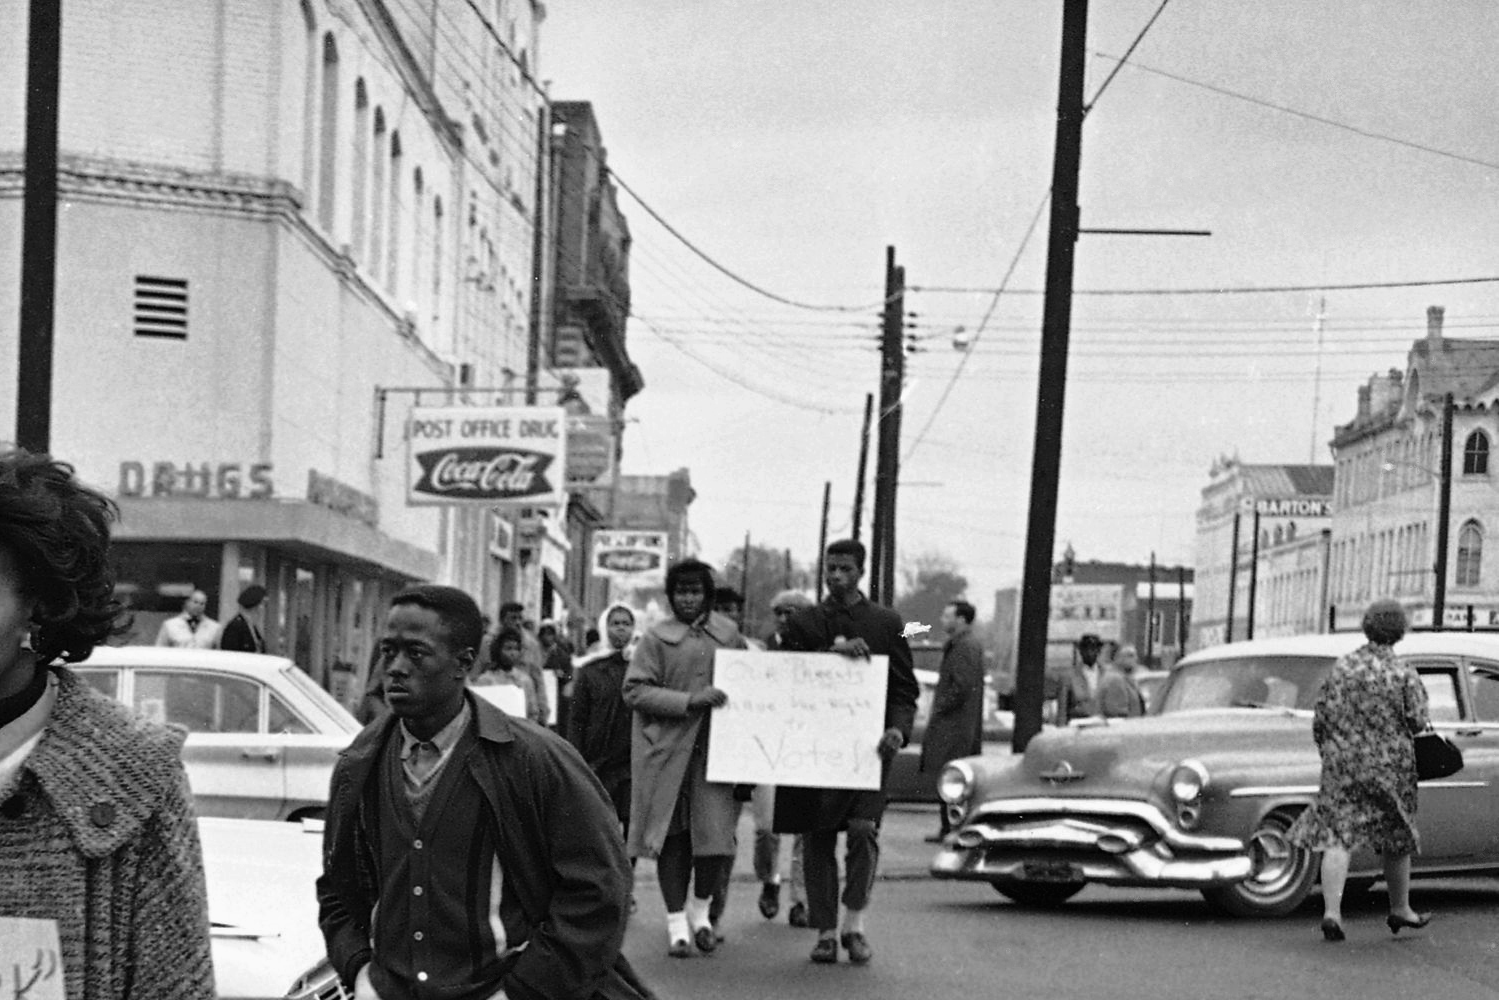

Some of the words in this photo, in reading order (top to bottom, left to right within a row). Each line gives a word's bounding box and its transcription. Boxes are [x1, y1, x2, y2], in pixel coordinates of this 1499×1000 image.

[413, 418, 454, 439] POST
[460, 418, 511, 439] OFFICE
[518, 418, 560, 439] DRUG
[117, 461, 274, 499] DRUGS
